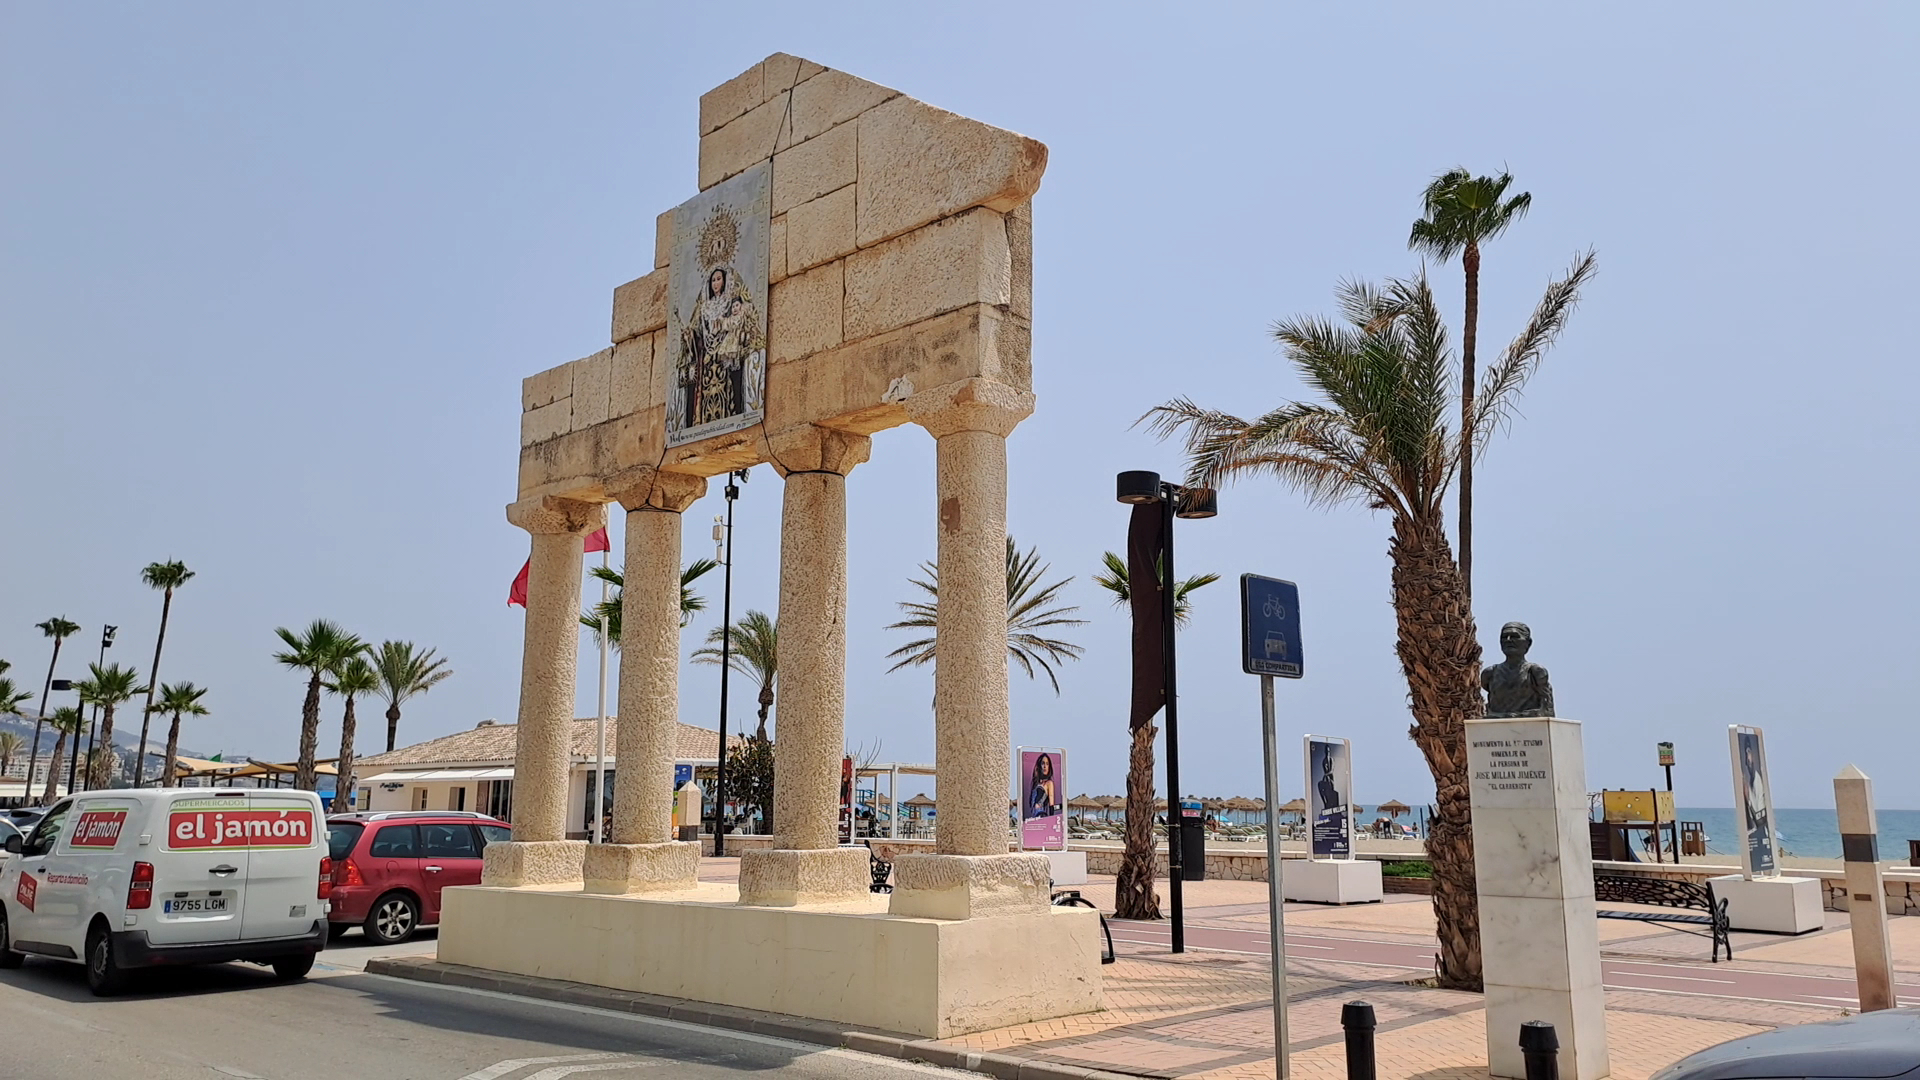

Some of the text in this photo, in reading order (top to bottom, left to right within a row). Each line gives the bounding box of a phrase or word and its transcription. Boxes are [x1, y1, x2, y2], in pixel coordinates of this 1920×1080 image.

[173, 799, 245, 808] SUPERMERCADOS
[76, 812, 120, 843] el jamón
[176, 810, 307, 844] el jamón
[172, 899, 226, 911] 9755 LGM
